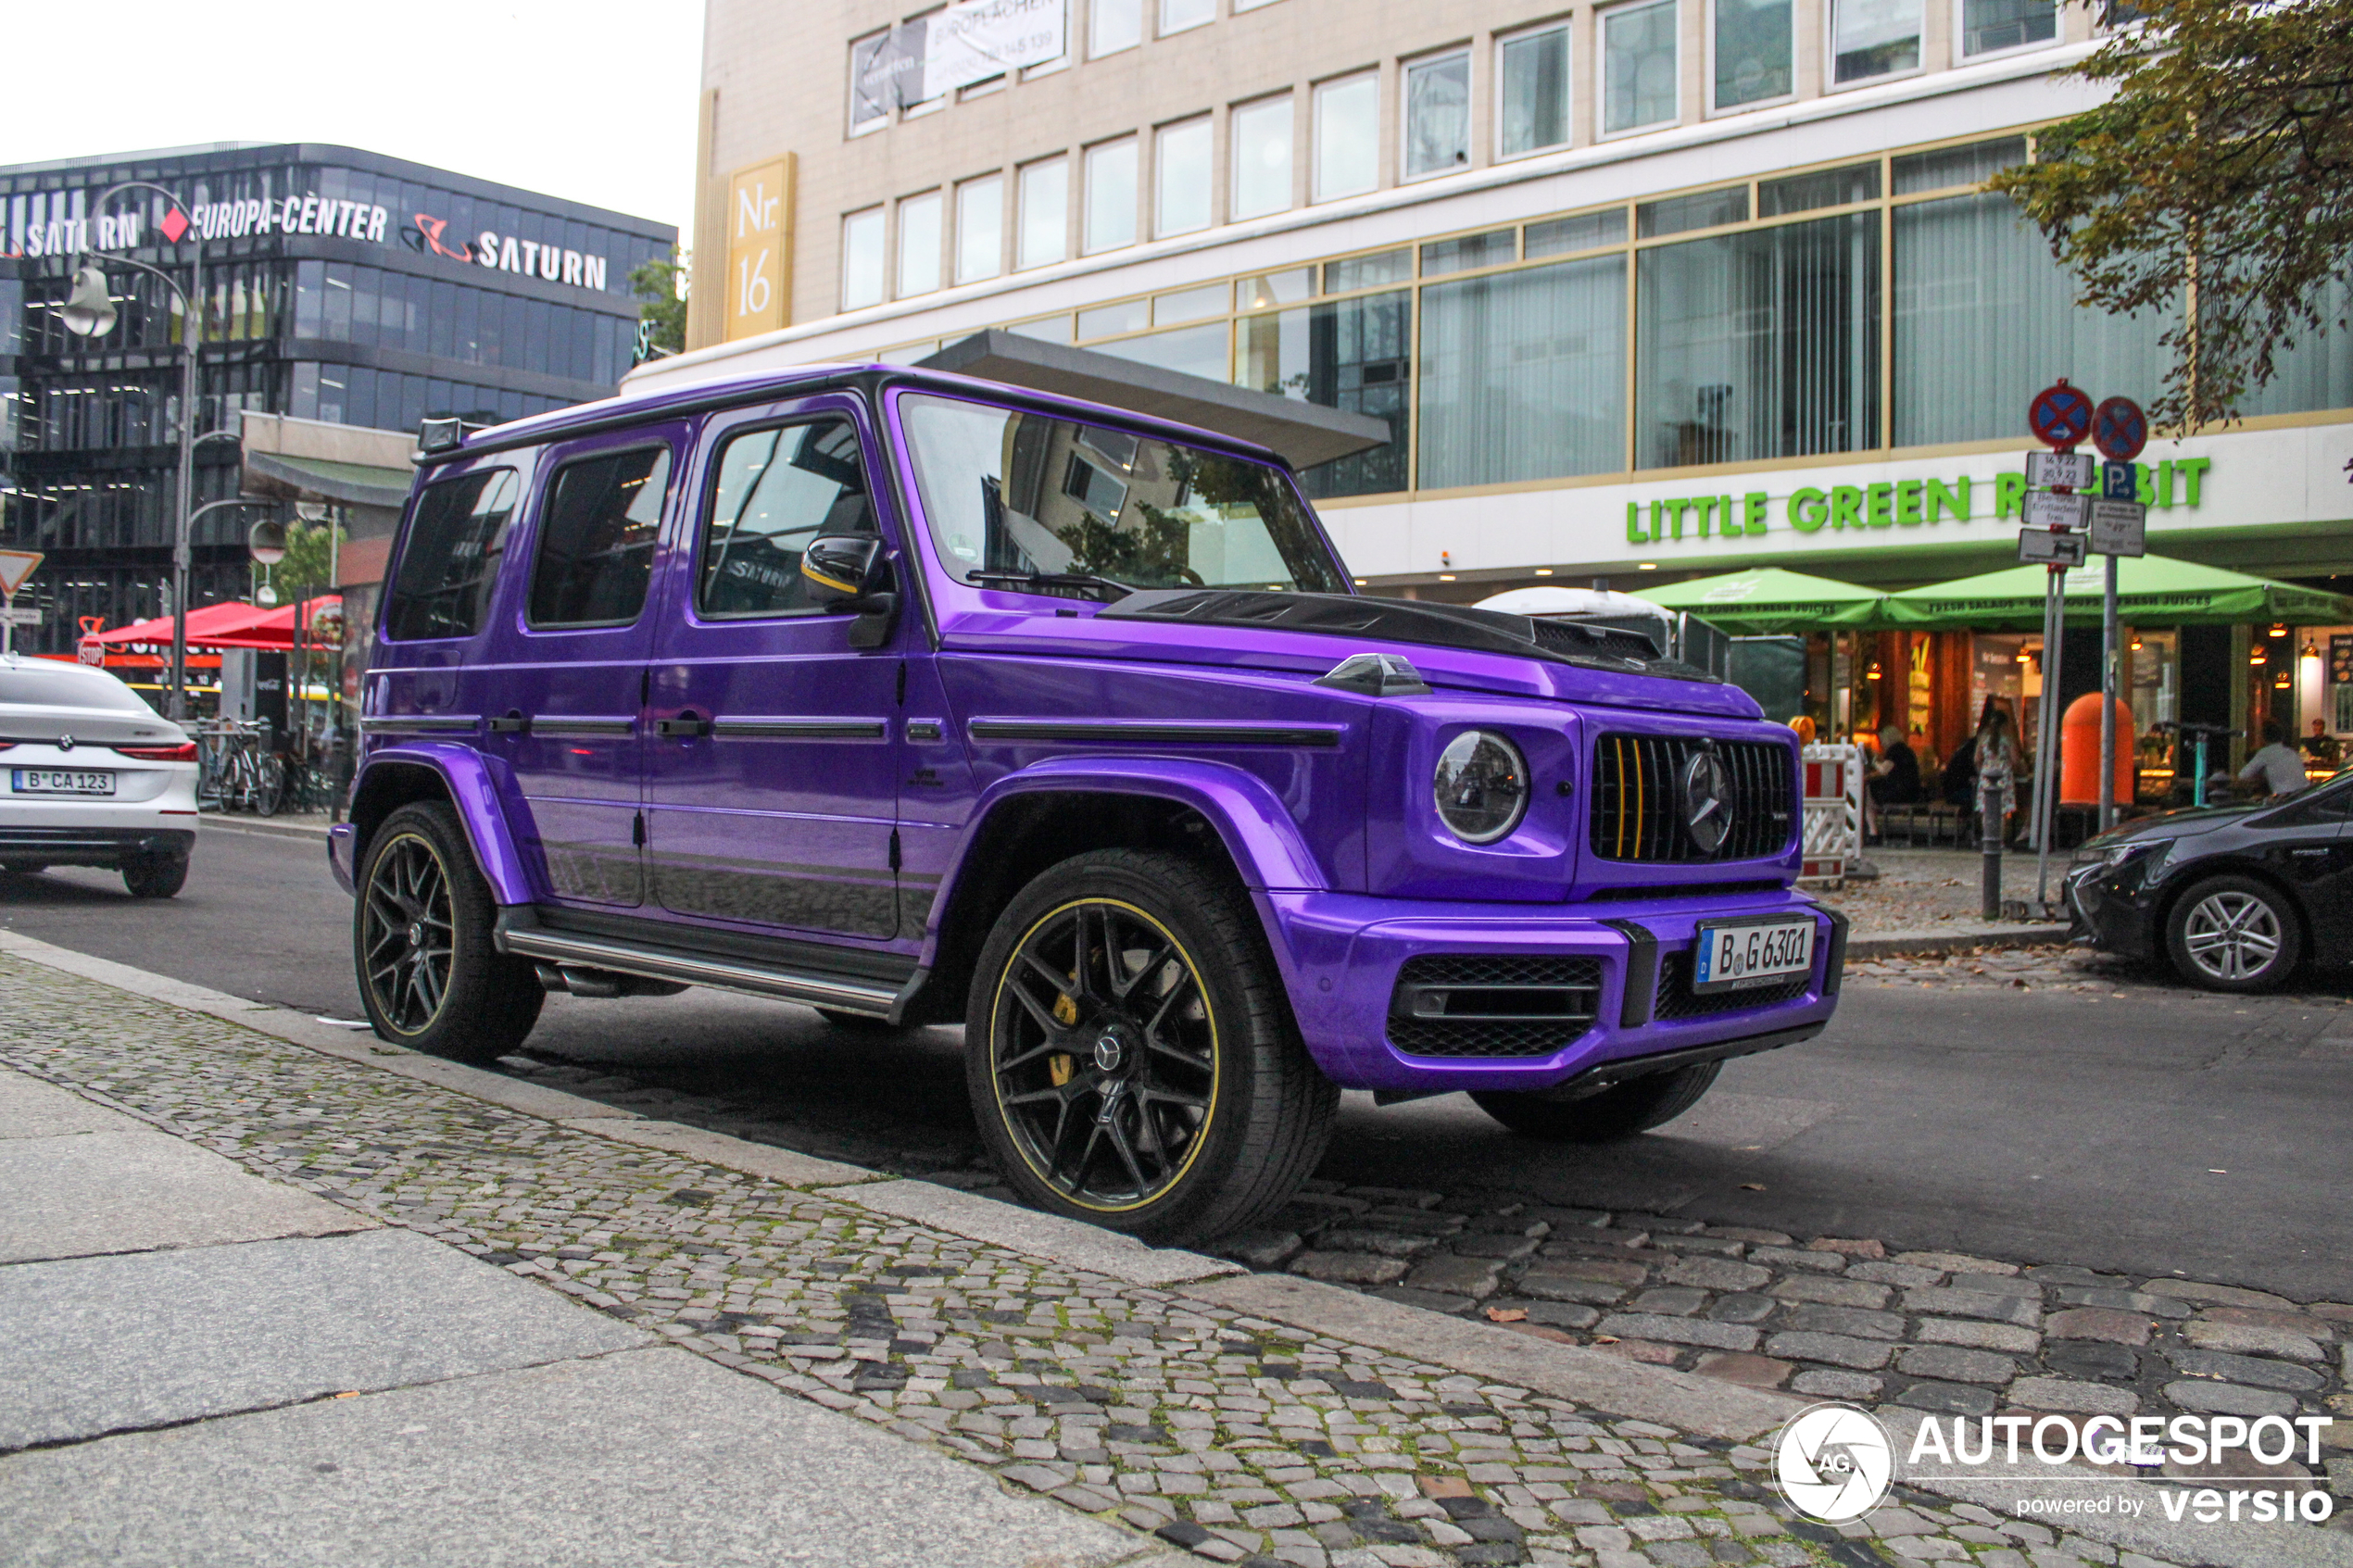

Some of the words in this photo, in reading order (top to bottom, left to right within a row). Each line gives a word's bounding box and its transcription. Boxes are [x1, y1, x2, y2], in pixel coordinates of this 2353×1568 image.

[737, 182, 779, 238] Nr.
[479, 231, 607, 293] SATURN
[739, 248, 771, 316] 16
[1627, 493, 1768, 544] LITTLE
[1787, 475, 1970, 532] GREEN
[1995, 458, 2209, 520] RBIT
[2108, 467, 2126, 495] P
[2163, 594, 2211, 607] JUICES
[81, 650, 104, 665] STOP
[29, 772, 40, 786] B
[52, 773, 74, 788] CA
[78, 775, 107, 789] 123
[1720, 934, 1734, 973] B
[1746, 931, 1759, 971] G
[1762, 928, 1806, 967] 6301
